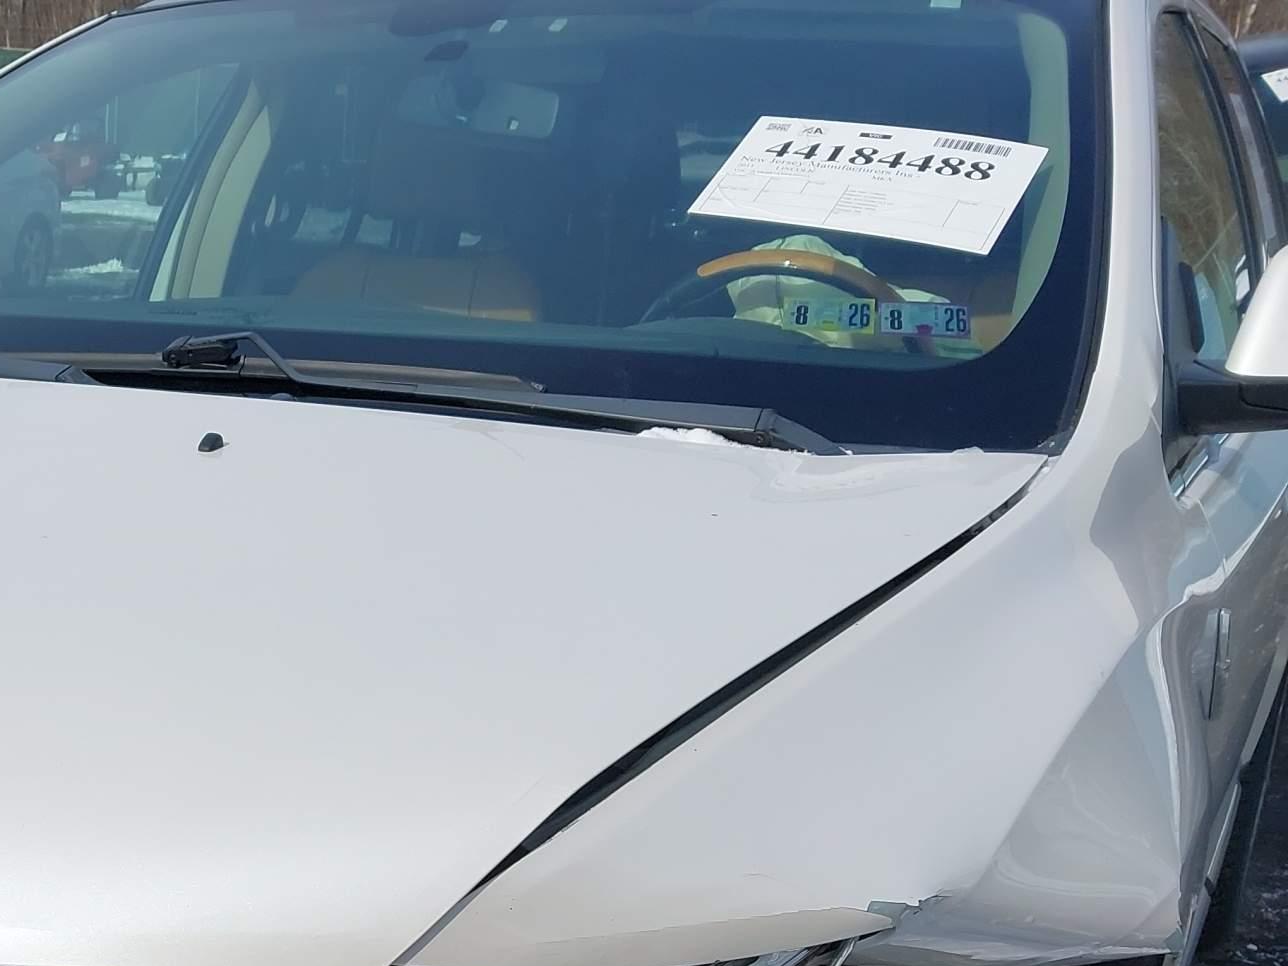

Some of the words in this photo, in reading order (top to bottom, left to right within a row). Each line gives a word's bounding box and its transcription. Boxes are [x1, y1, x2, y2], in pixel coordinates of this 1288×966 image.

[740, 155, 765, 164] New
[770, 157, 802, 168] Jersey
[808, 160, 891, 175] Manufacturers
[765, 140, 996, 181] 44184488
[796, 305, 809, 325] 8
[848, 303, 871, 328] 26
[889, 308, 903, 331] 8
[943, 307, 968, 333] 26
